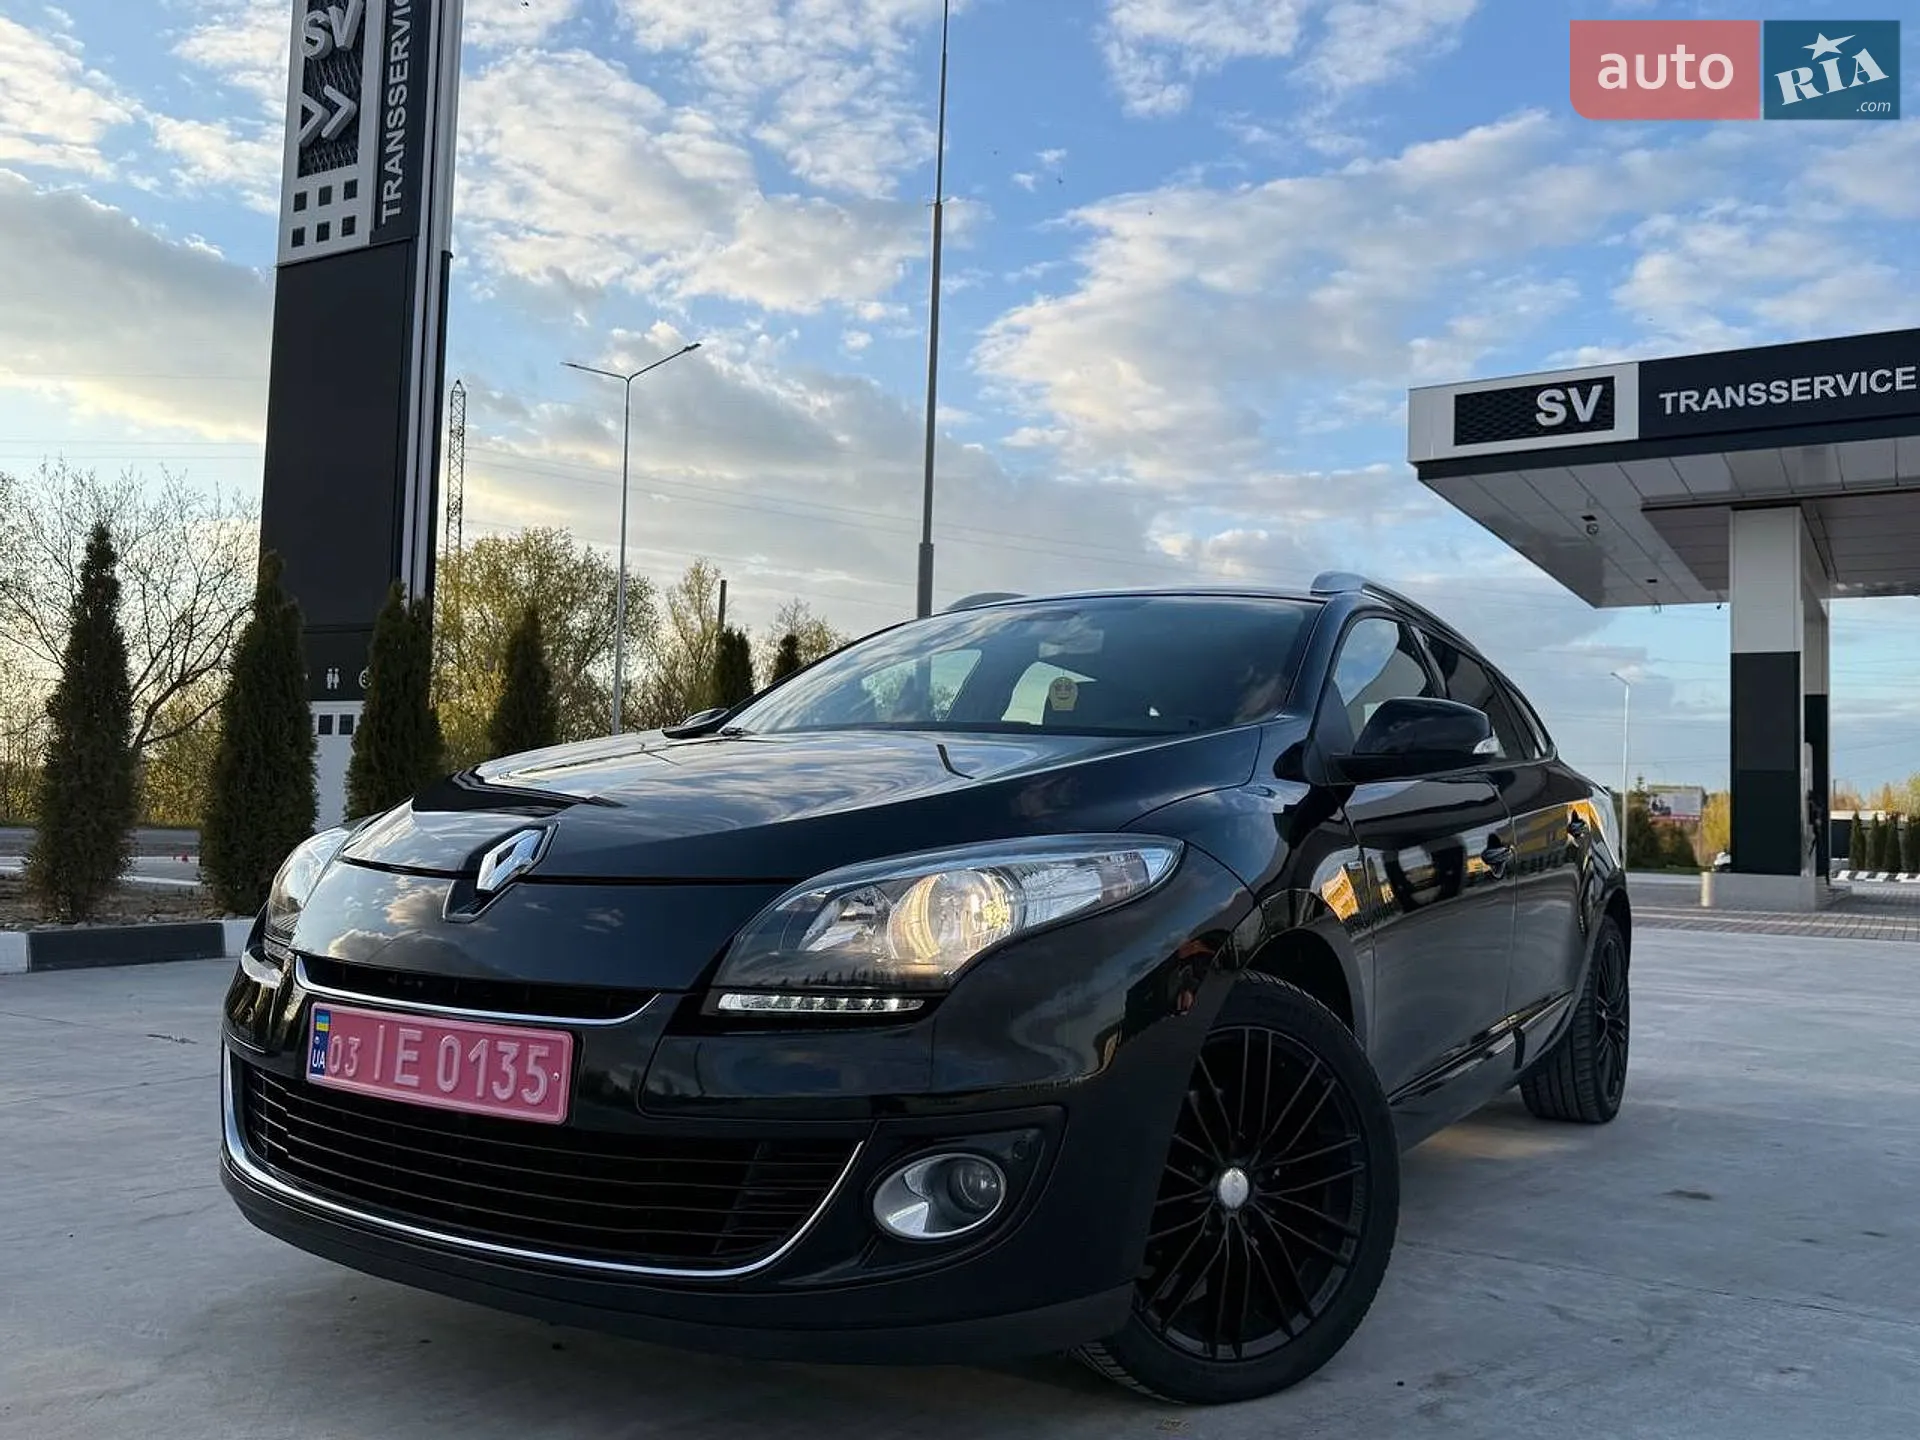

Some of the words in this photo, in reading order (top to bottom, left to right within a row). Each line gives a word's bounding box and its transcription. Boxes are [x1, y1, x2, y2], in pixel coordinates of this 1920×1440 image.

[300, 0, 363, 59] SV
[1535, 384, 1603, 427] SV
[1658, 365, 1917, 415] TRANSSERVICE
[311, 1050, 326, 1070] UA
[328, 1035, 361, 1077] 03
[436, 1034, 549, 1105] 0135
